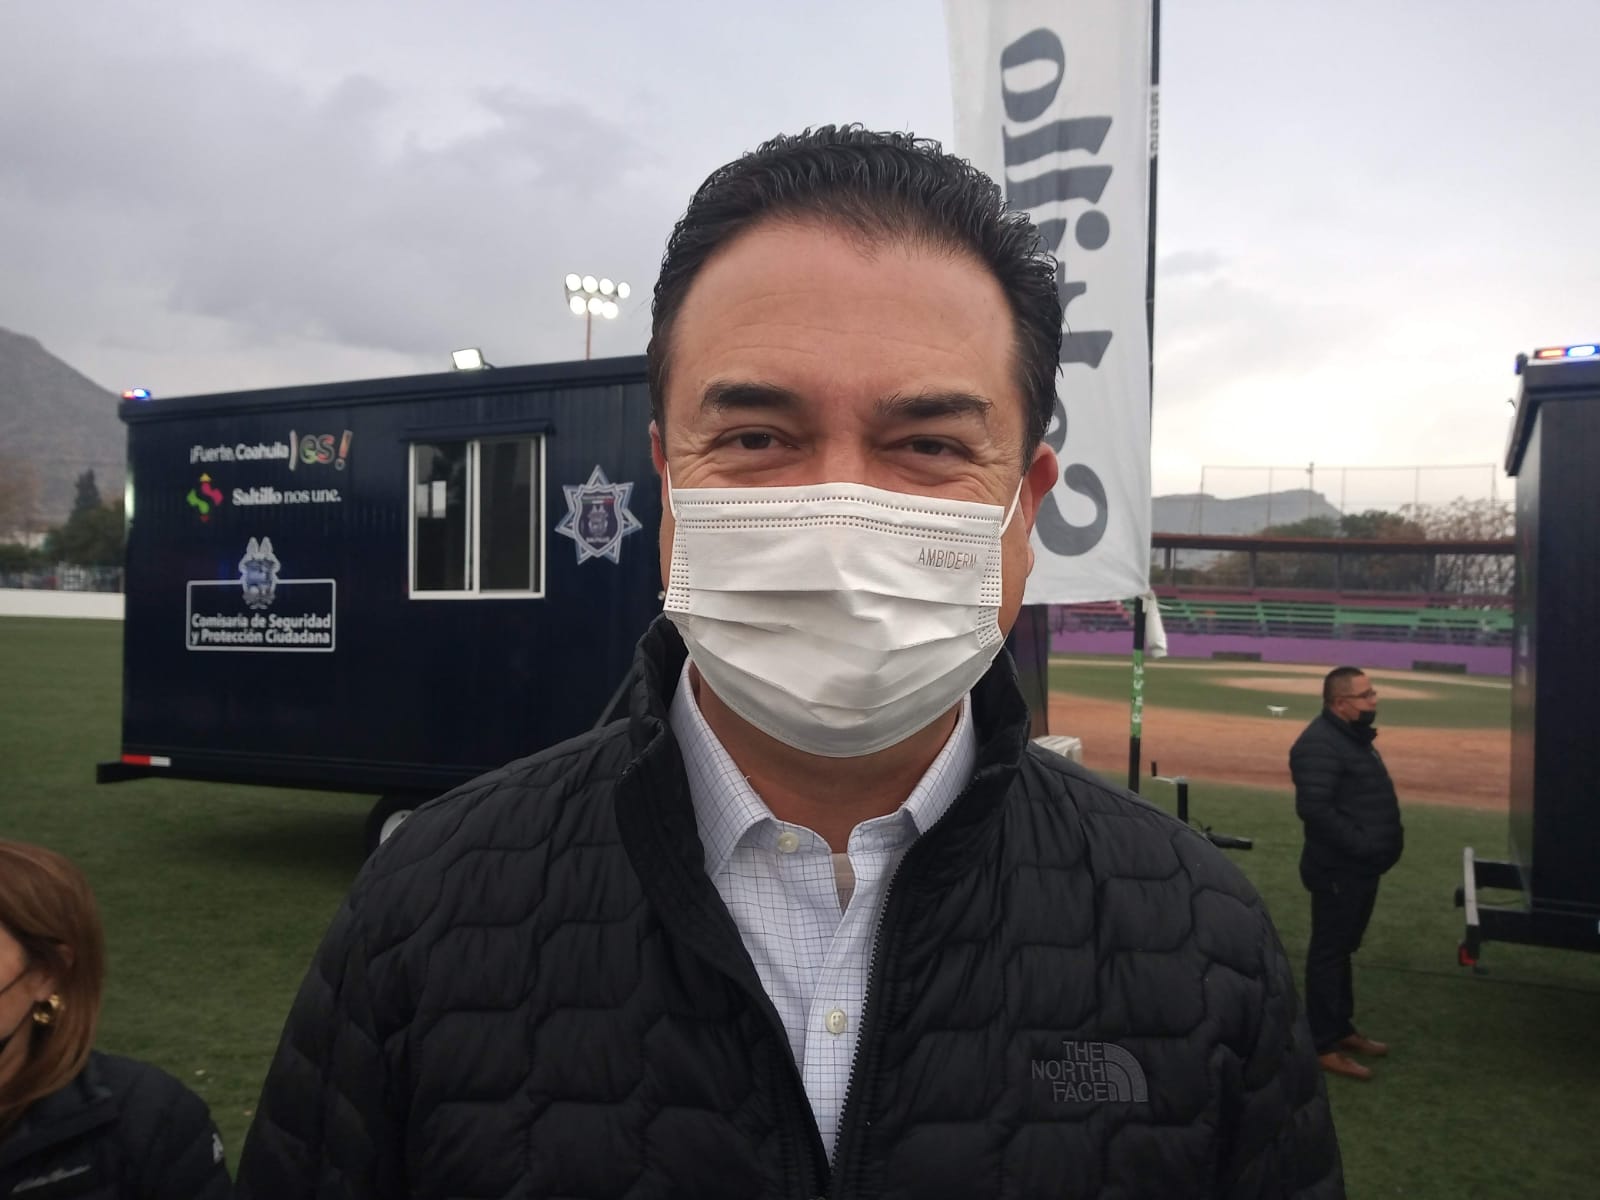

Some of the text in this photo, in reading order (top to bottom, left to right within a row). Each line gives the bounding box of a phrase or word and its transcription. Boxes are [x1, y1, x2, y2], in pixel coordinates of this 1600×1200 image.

[235, 441, 289, 461] Coahuila
[232, 487, 341, 506] Saltillo nos une.
[250, 613, 266, 628] de
[268, 613, 331, 632] Seguridad
[191, 628, 330, 645] y Protección Ciudadana
[1062, 1041, 1104, 1062] THE
[1031, 1060, 1106, 1082] NORTH
[1052, 1081, 1108, 1103] FACE
